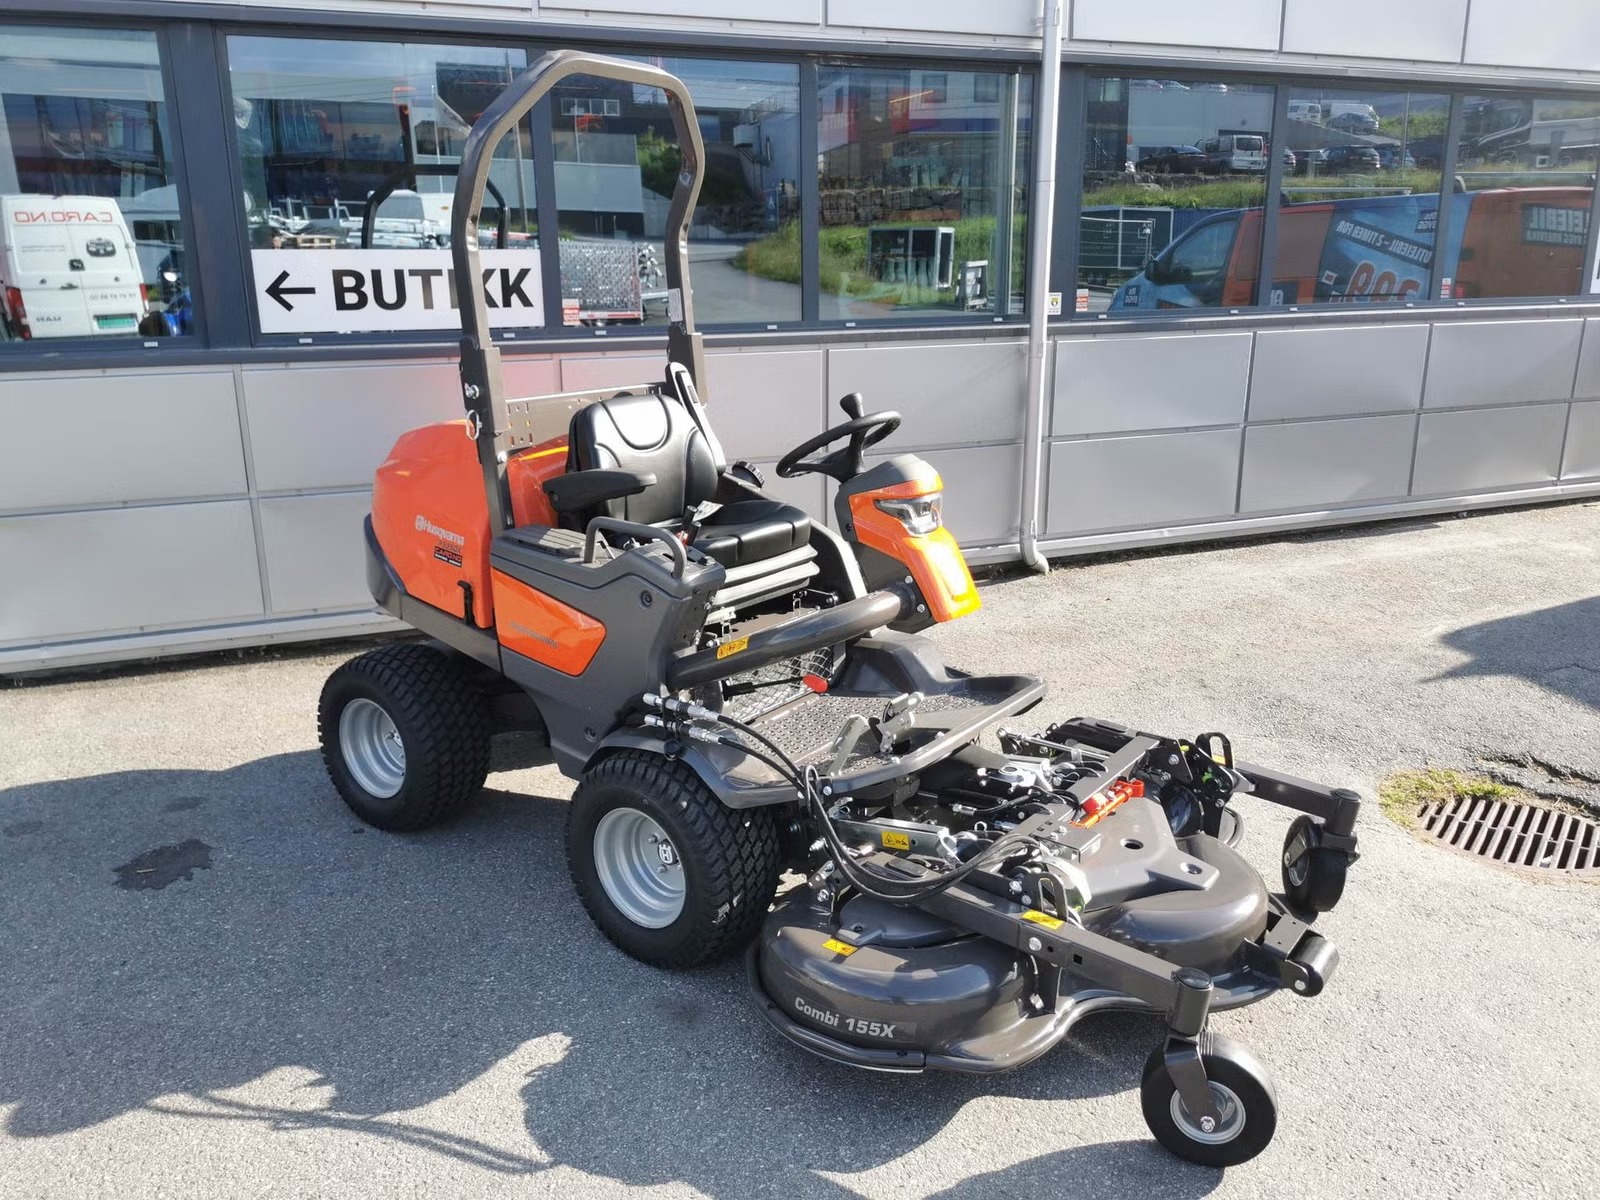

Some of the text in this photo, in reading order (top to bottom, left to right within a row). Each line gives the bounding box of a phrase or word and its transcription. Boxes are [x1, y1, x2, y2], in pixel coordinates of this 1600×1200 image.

[422, 516, 464, 545] Husqvarna
[794, 996, 896, 1038] Combi 155X
